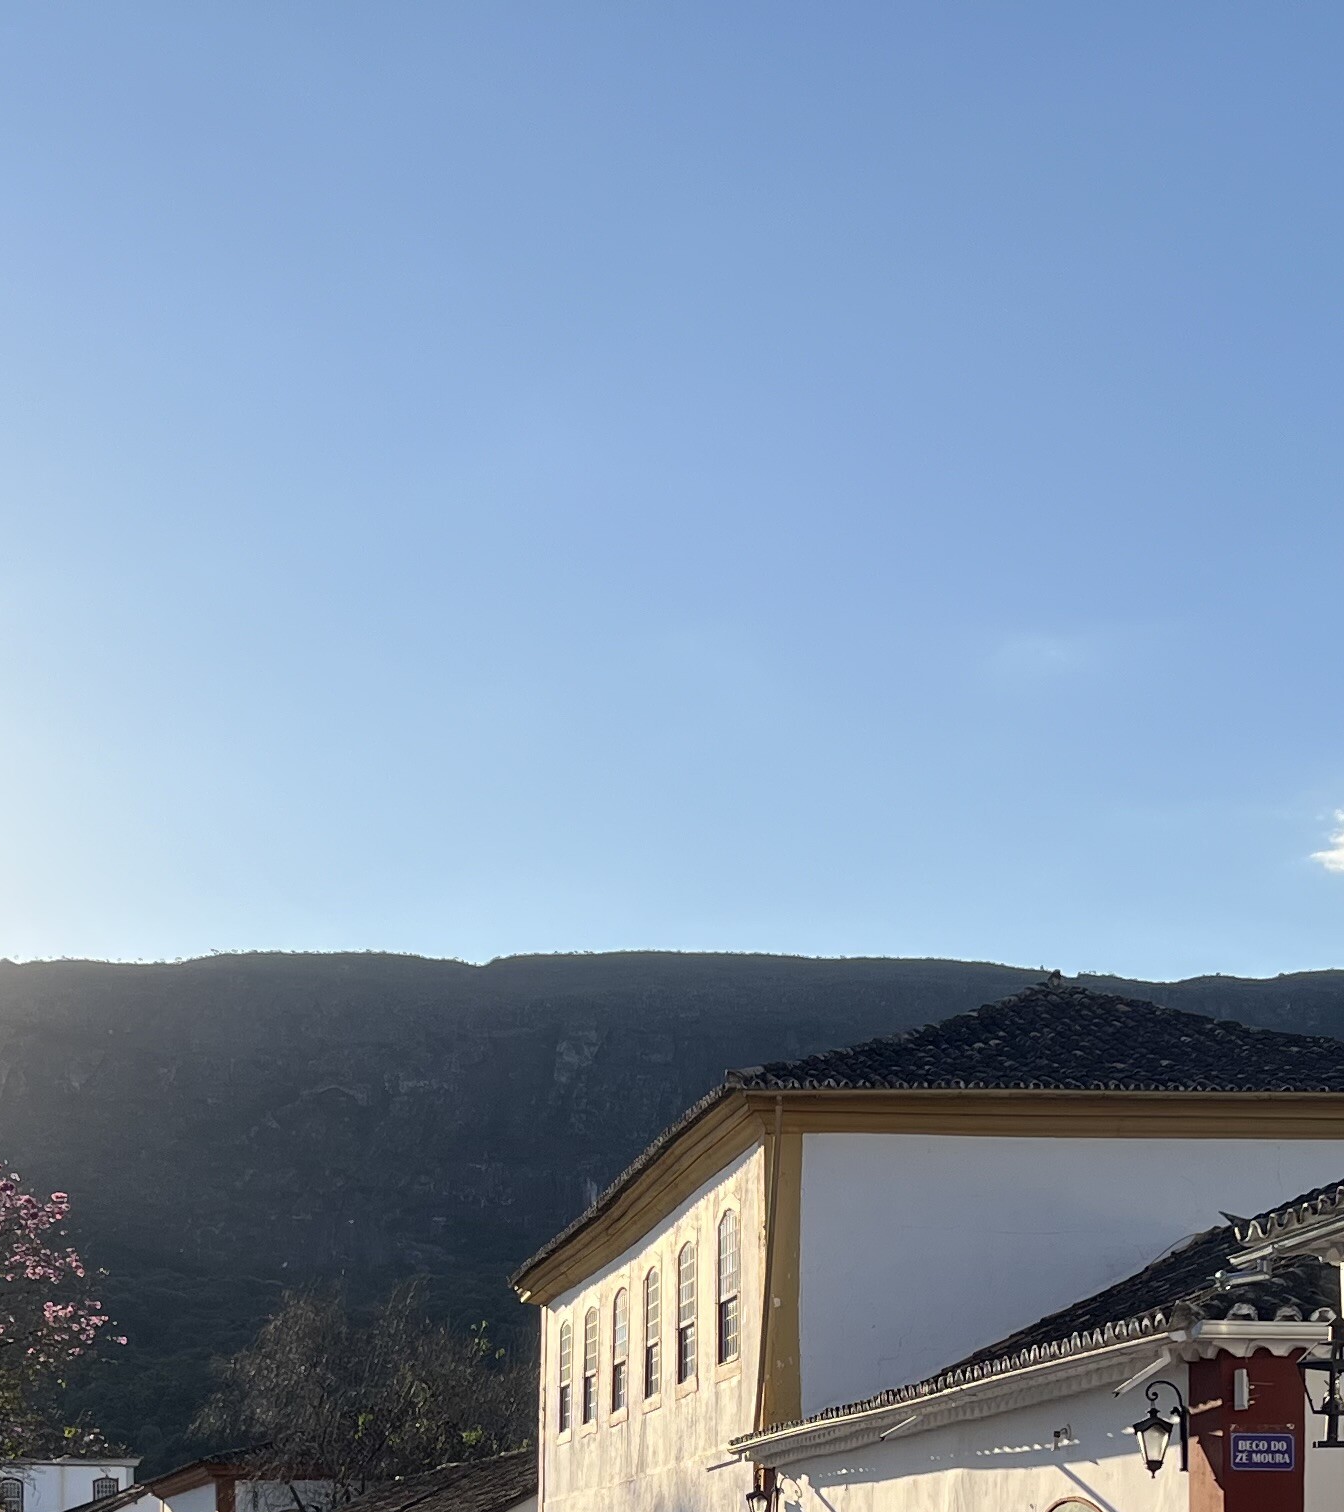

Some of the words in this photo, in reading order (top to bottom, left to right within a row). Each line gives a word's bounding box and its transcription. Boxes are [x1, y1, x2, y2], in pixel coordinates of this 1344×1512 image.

[1238, 1440, 1267, 1451] BECO
[1271, 1441, 1287, 1451] DO
[1235, 1452, 1248, 1463] ZÉ
[1252, 1453, 1290, 1463] MOURA
